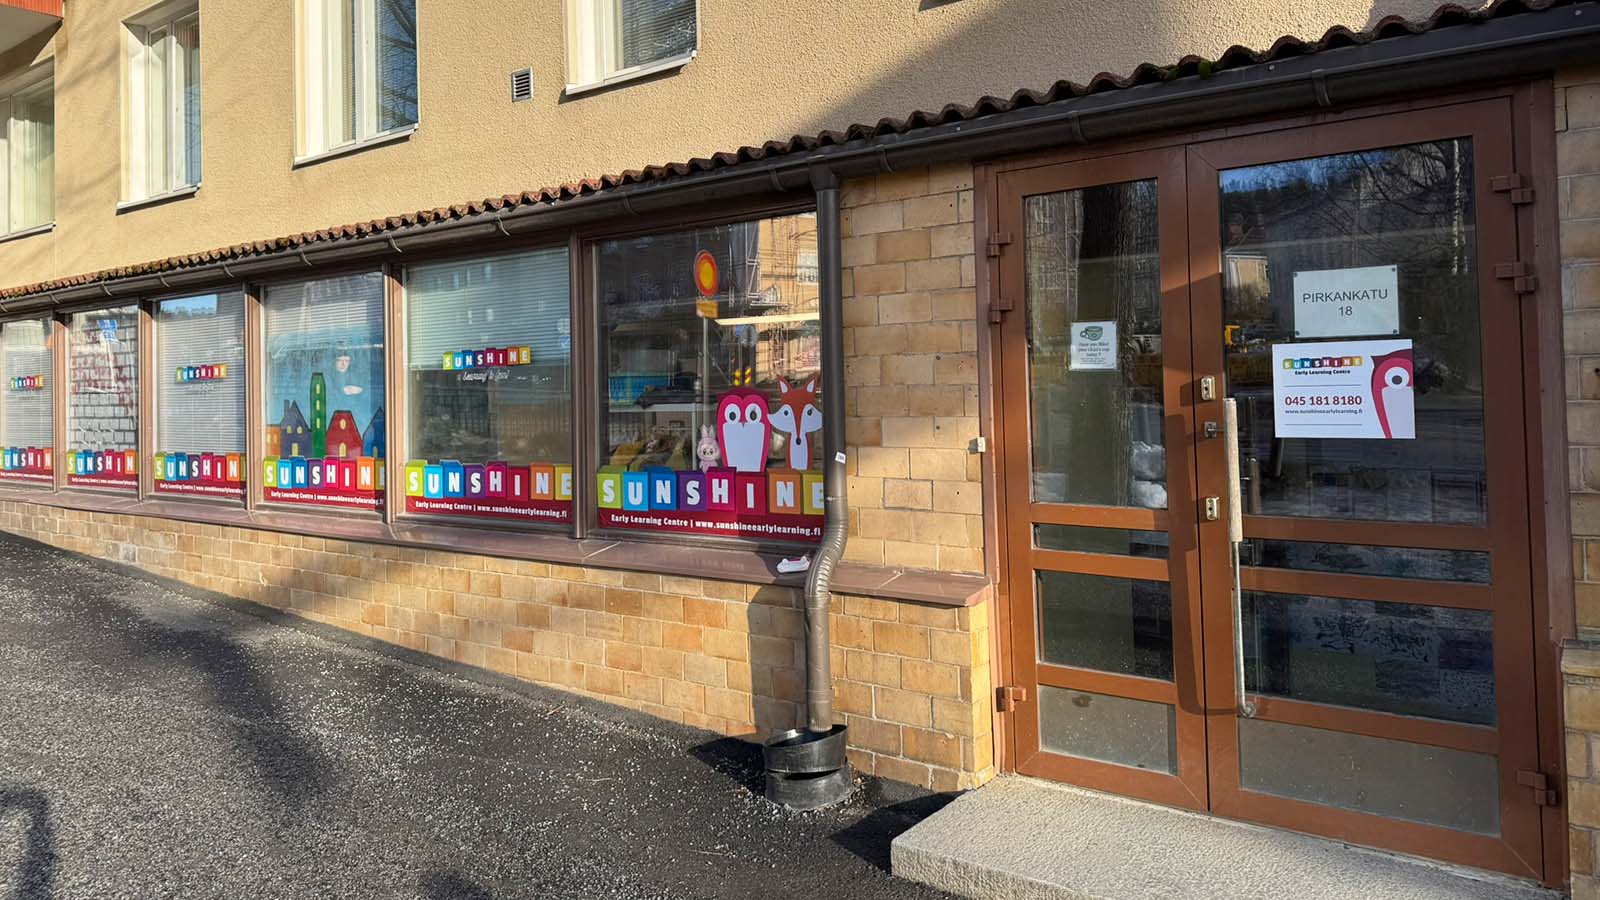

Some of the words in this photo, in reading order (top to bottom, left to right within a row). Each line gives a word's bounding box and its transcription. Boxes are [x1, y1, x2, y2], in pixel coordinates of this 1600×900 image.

[1302, 288, 1389, 303] PIRKANKATU
[1338, 305, 1353, 317] 18
[445, 350, 528, 370] SUNSHINE
[1283, 358, 1362, 369] SUNSHINE
[1285, 396, 1306, 406] 045
[1309, 396, 1330, 406] 181
[1333, 395, 1362, 406] 8180
[68, 455, 133, 473] SUNSHIN
[156, 459, 246, 479] SUNSHIN
[409, 471, 572, 496] SUNSHINE
[602, 478, 824, 509] SUNSHINE
[415, 500, 429, 509] Early
[429, 501, 453, 510] Learning
[453, 502, 472, 511] Centre
[477, 504, 567, 519] www.sunshineearlylearning.fi
[611, 514, 630, 524] Early
[630, 515, 662, 526] Learning
[663, 517, 688, 527] Centre
[695, 520, 821, 536] www.sunshineearlylearning.fi
